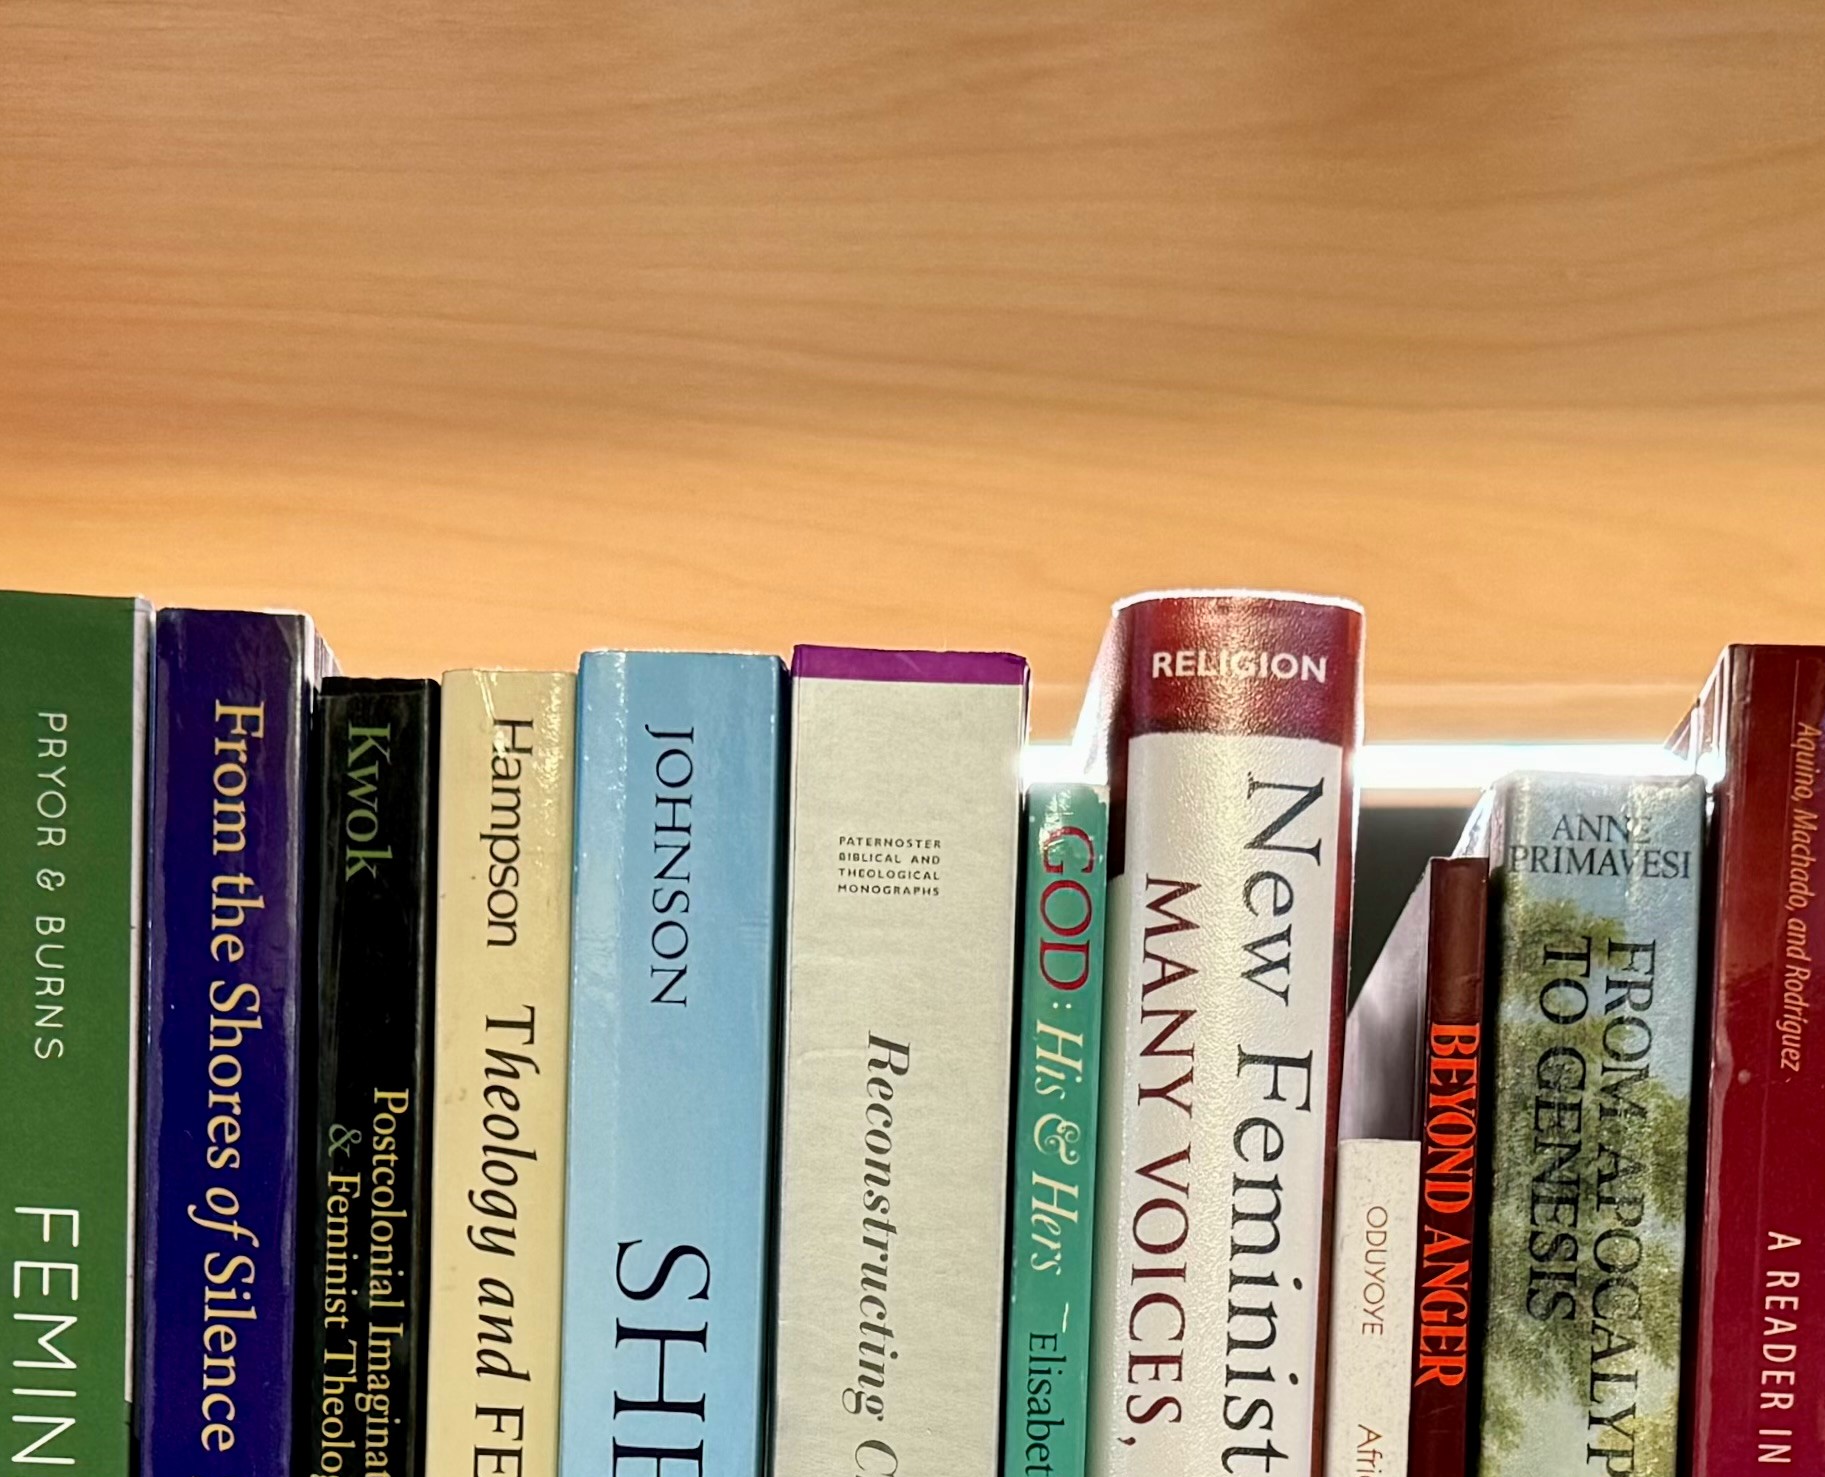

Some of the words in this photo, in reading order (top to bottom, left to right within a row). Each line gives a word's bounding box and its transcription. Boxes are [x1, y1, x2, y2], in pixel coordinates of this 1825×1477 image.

[1152, 651, 1328, 684] RELIGION
[213, 699, 265, 857] From
[479, 718, 534, 949] Hampson
[645, 725, 695, 1008] JOHNSON
[839, 836, 942, 850] PATERNOSTER
[839, 852, 902, 864] BIBLICAL
[910, 853, 941, 865] AND
[1510, 845, 1692, 880] PRIMAVESI
[210, 873, 263, 963] the
[838, 867, 941, 880] THEOLOGICAL
[838, 883, 941, 896] MONOGRAPHS
[1242, 773, 1325, 1008] New
[1138, 876, 1202, 1118] MANY
[1541, 936, 1591, 1027] TO
[1600, 940, 1657, 1123] FROM
[205, 981, 262, 1170] Shores
[467, 1004, 538, 1257] Theology
[1425, 1023, 1480, 1215] BEYOND
[188, 1188, 260, 1248] of
[841, 1030, 910, 1412] Reconstructing
[1219, 1045, 1314, 1477] Feminist
[1527, 1044, 1588, 1324] GENESIS
[200, 1251, 257, 1453] Silence
[474, 1268, 531, 1382] and
[1118, 1141, 1188, 1445] VOICES,
[1413, 1221, 1479, 1390] ANGER
